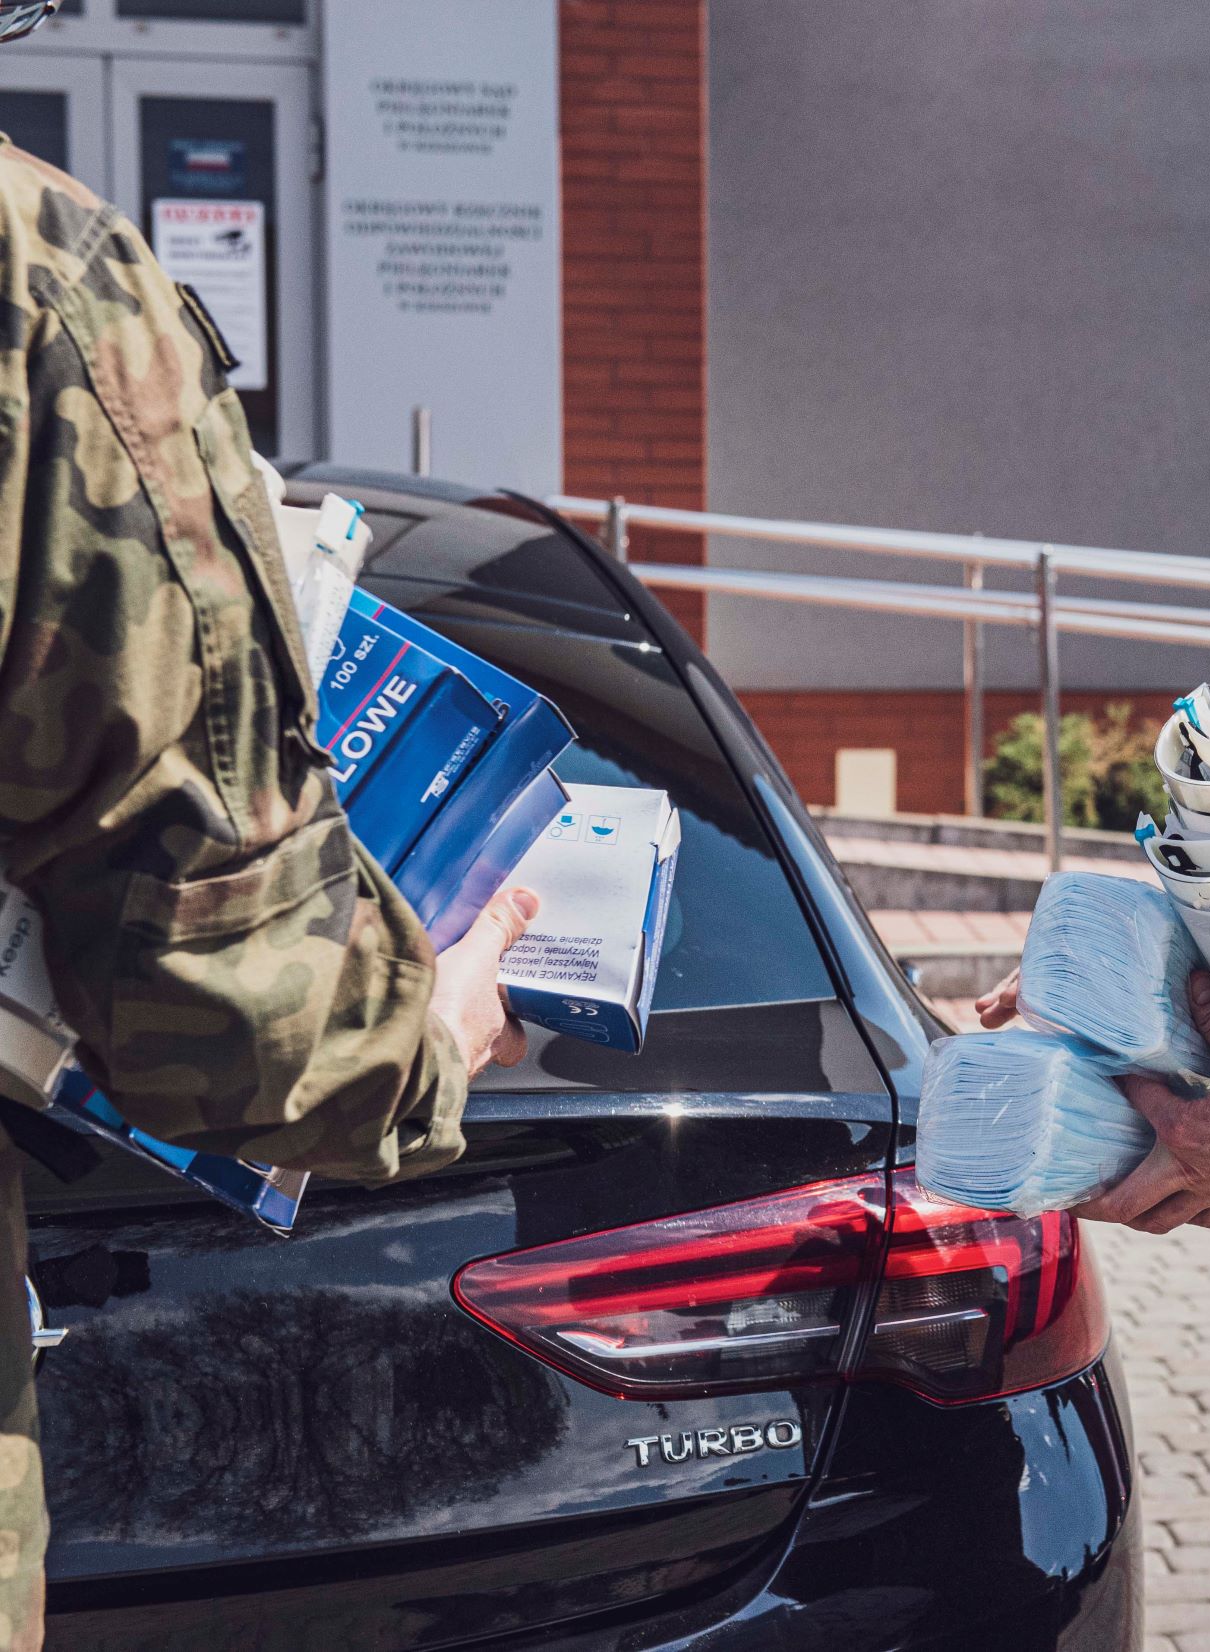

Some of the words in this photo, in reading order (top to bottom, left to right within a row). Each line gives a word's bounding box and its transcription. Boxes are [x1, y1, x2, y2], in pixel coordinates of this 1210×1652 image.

[330, 661, 359, 690] 100
[354, 633, 380, 661] szt.
[559, 936, 603, 945] działanie
[538, 945, 542, 954] i
[544, 946, 599, 958] Wytrzymałe
[508, 956, 544, 966] jakości
[544, 956, 598, 969] Najwyższej
[540, 970, 597, 982] RĘKAWICE
[623, 1419, 803, 1467] TURBO
